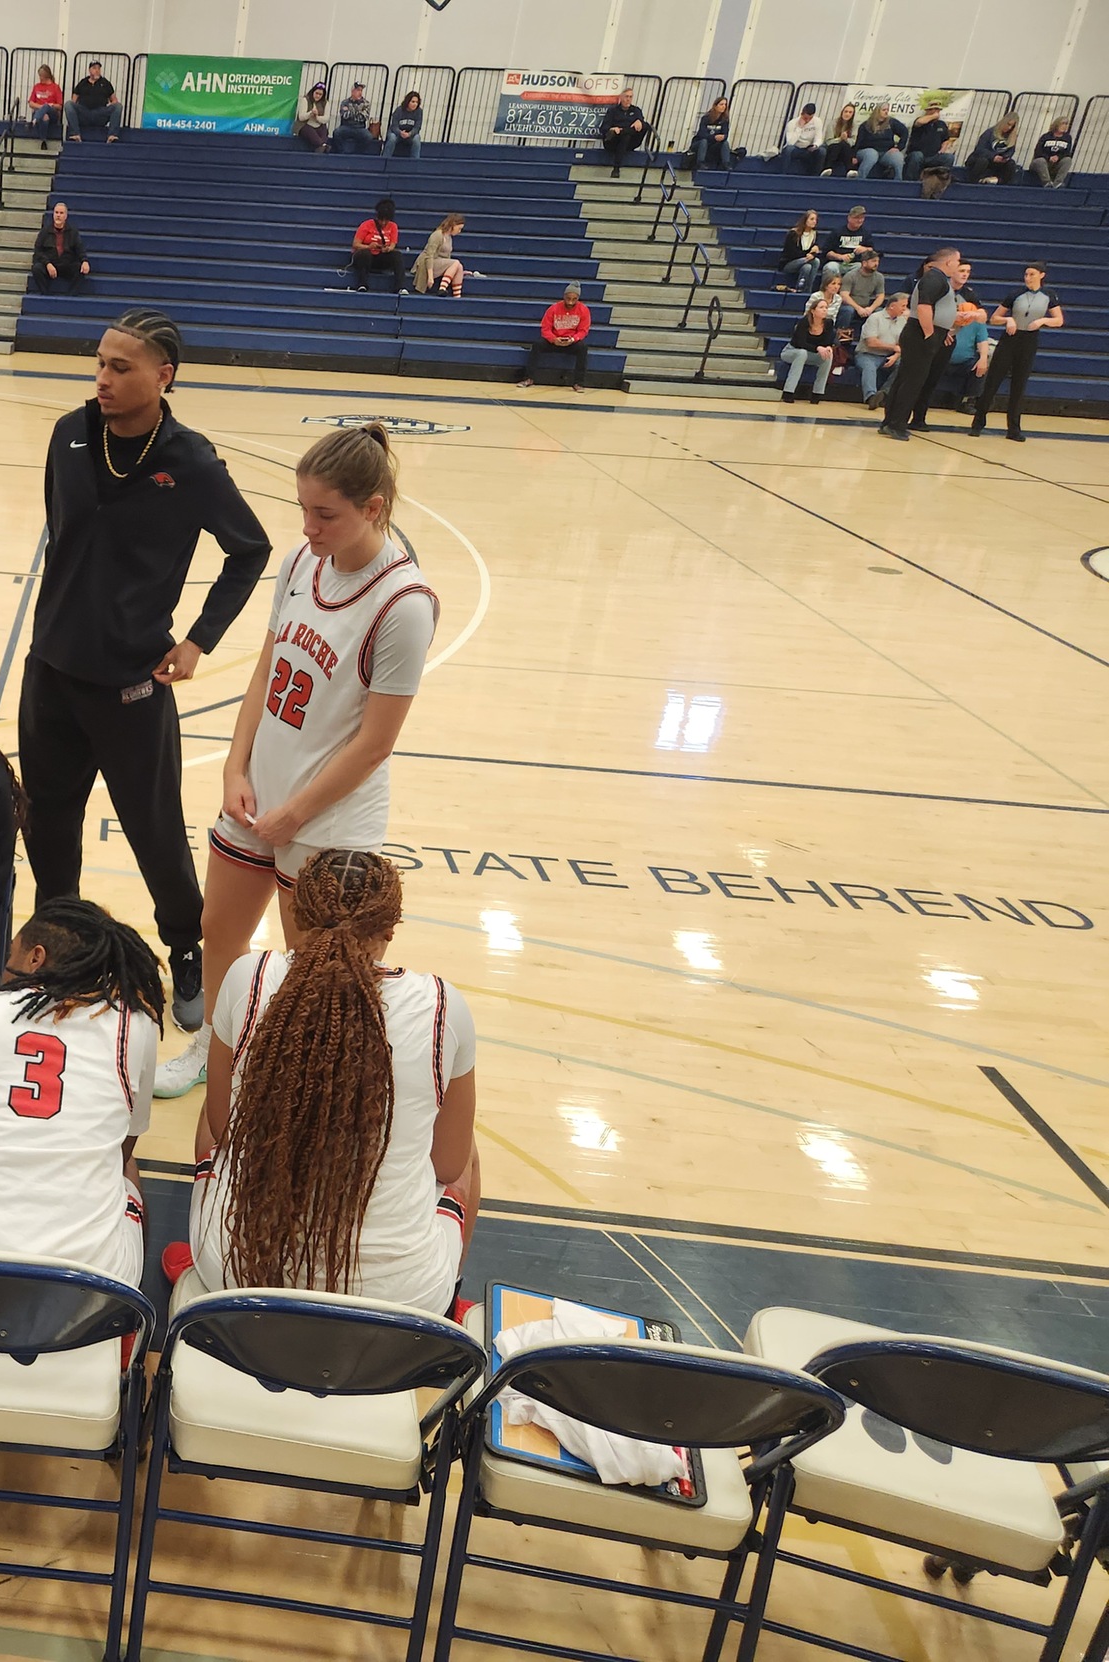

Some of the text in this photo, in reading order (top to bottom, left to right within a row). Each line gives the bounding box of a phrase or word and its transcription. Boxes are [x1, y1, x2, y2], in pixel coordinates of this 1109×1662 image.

[181, 71, 293, 93] AHN ORTHOPAEDIC
[227, 84, 274, 95] INSTITUTE
[520, 74, 619, 90] HUDSON LOFTS
[849, 101, 916, 114] PARENTS
[156, 119, 280, 135] 814-454-2401 AHN.org
[506, 109, 606, 128] 814.616.2727
[274, 621, 339, 681] LA ROCHE
[266, 656, 314, 730] 22
[379, 842, 1094, 930] STATE BEHREND
[7, 1030, 67, 1120] 3
